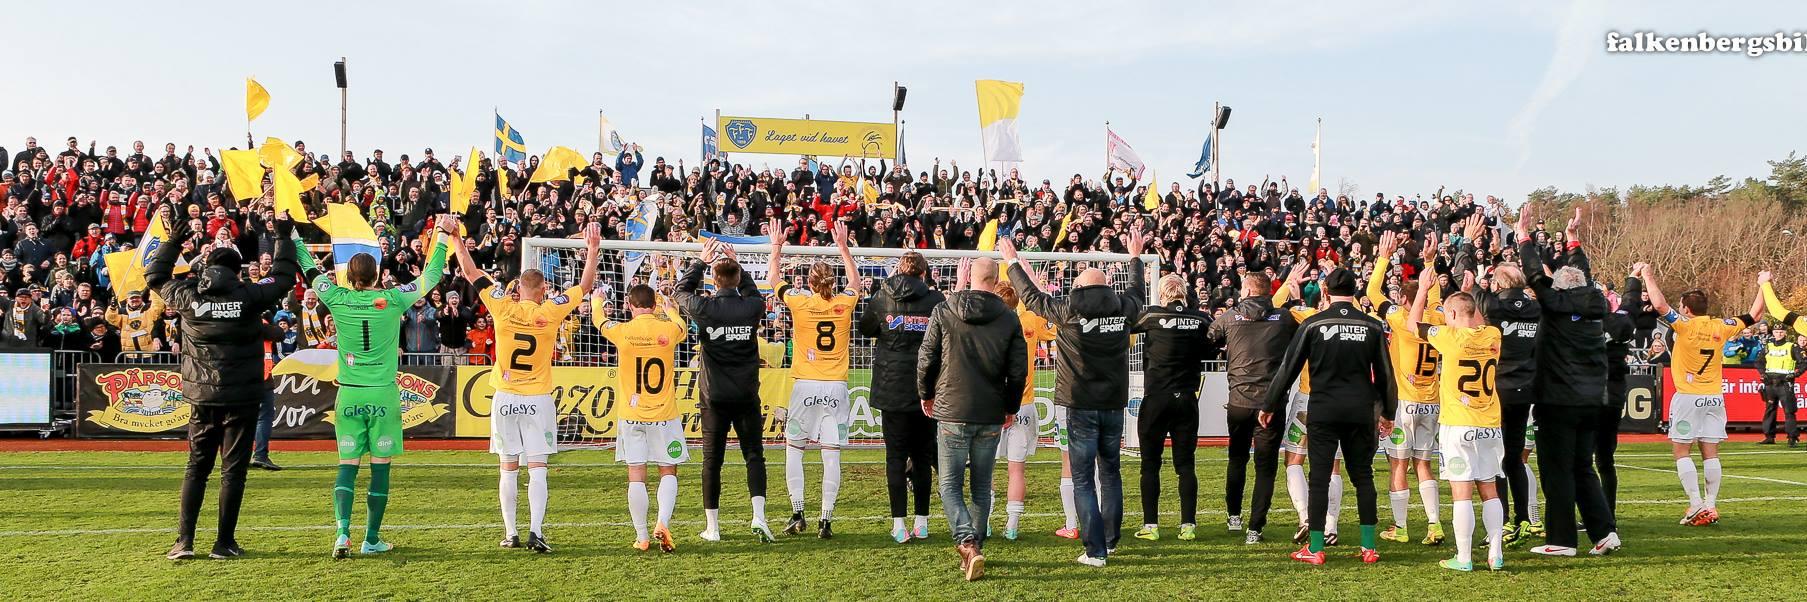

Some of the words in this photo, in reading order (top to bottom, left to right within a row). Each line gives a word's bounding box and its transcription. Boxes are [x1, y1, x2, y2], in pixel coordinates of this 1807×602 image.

[765, 130, 797, 145] Laget
[800, 130, 818, 142] vid
[819, 131, 849, 144] havet
[211, 302, 240, 310] INTER
[211, 310, 241, 318] SPORT
[1100, 317, 1125, 325] INTER
[1517, 322, 1537, 330] INTER
[725, 326, 750, 334] INTER
[1100, 323, 1125, 332] SPORT
[1340, 325, 1366, 333] INTER
[362, 320, 370, 351] 1
[816, 321, 836, 351] 8
[1340, 333, 1366, 341] SPORT
[510, 333, 537, 371] 2
[1697, 349, 1714, 375] 7
[635, 357, 665, 394] 10
[1457, 358, 1497, 397] 20
[98, 369, 183, 405] PÄRSO
[803, 396, 840, 408] GleSYS
[1621, 388, 1652, 420] G
[1695, 397, 1723, 408] GleSY
[343, 404, 387, 417] GleSYS
[500, 404, 537, 416] GleSYS
[113, 413, 128, 424] Bra
